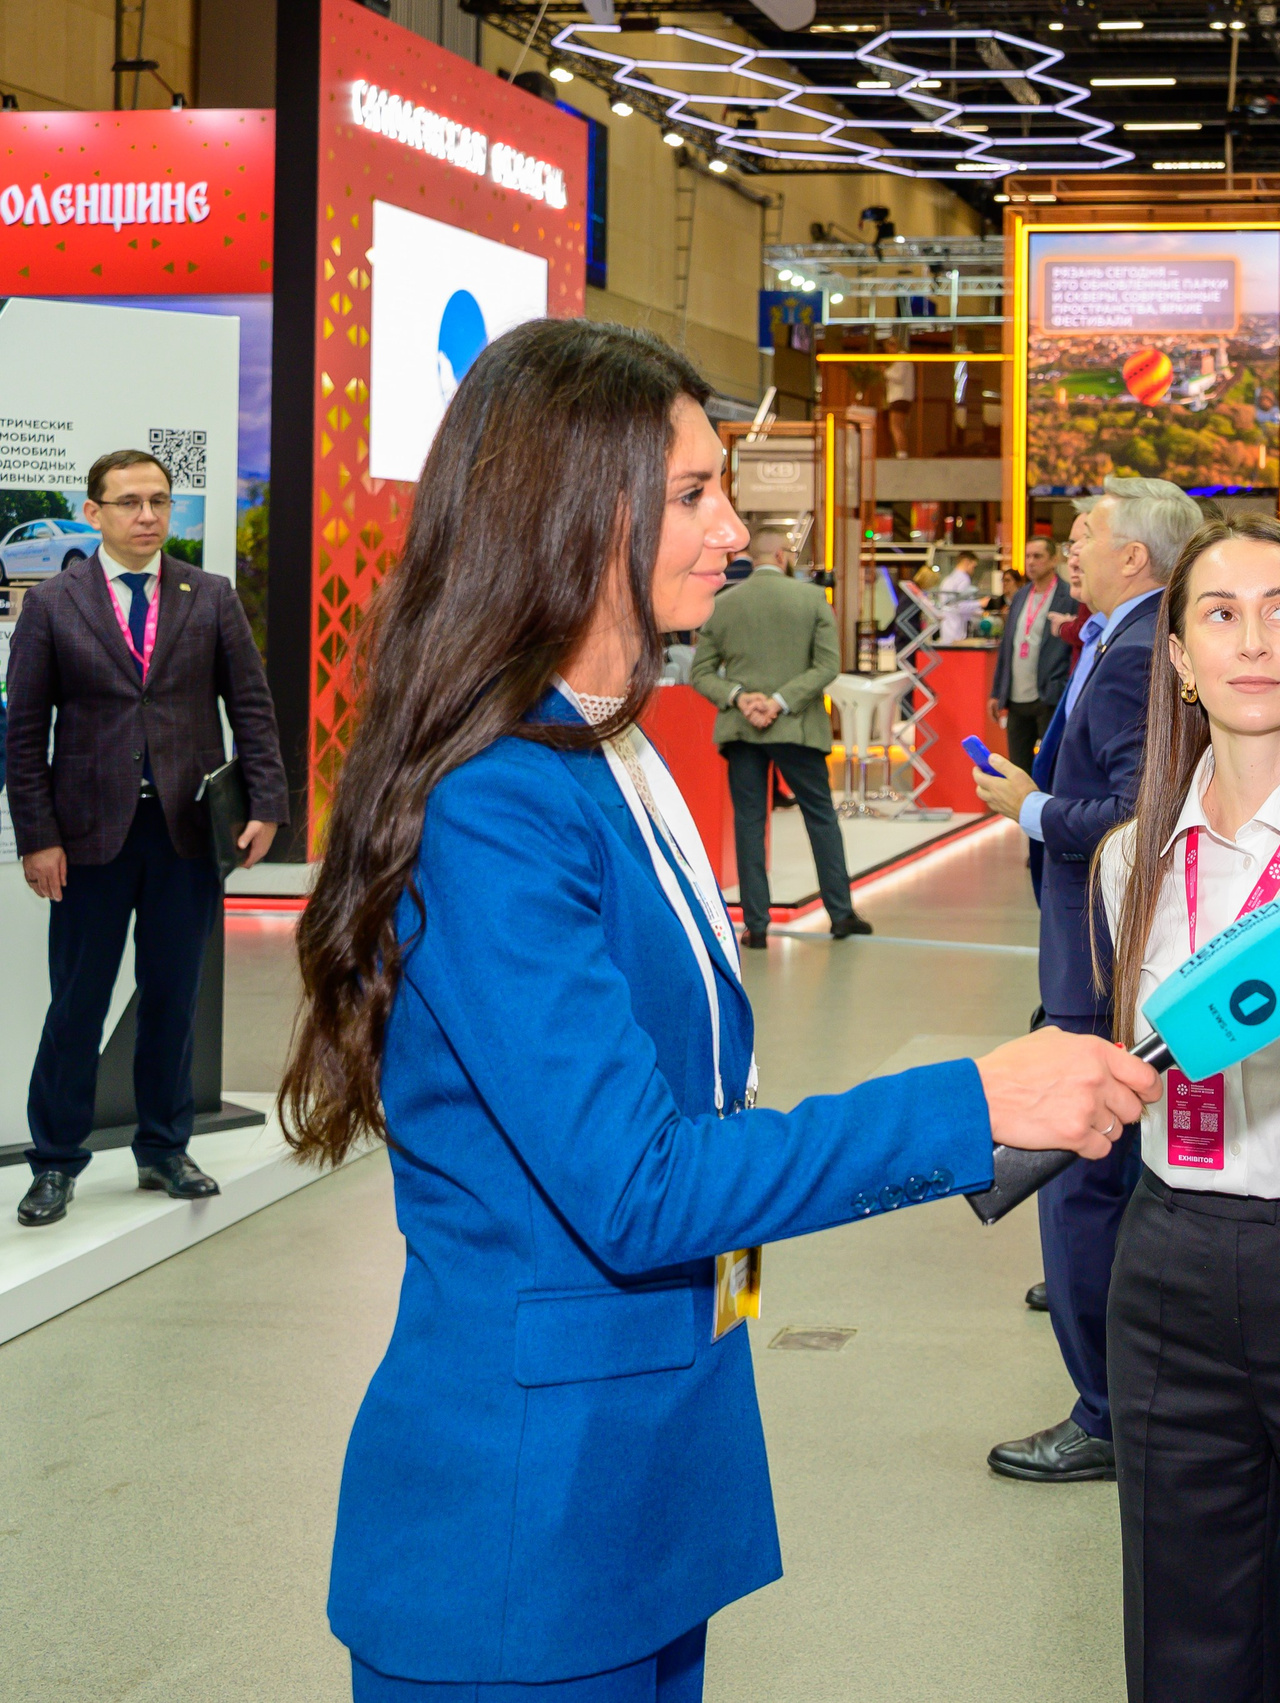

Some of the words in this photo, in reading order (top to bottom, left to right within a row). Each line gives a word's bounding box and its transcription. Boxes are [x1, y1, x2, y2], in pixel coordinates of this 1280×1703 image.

[0, 181, 211, 233] ОЛЕНЩИНЕ
[1052, 266, 1104, 279] РЯЗАНЬ
[1105, 266, 1167, 279] СЕГОДНЯ
[1052, 279, 1079, 291] ЭТО
[1182, 279, 1229, 290] ПАРКИ
[1052, 316, 1133, 327] ФЕСТИВАЛИ
[0, 418, 74, 431] ТРИЧЕСКИЕ
[0, 432, 55, 443] МОБИЛИ
[1, 445, 66, 457] ОМОБИЛИ
[0, 459, 76, 472] ДОРОДНЫХ
[0, 473, 46, 483] ИВНЫХ
[1179, 902, 1280, 974] ПЕРВЫЙ
[1178, 1154, 1214, 1164] EXHIBITOR
